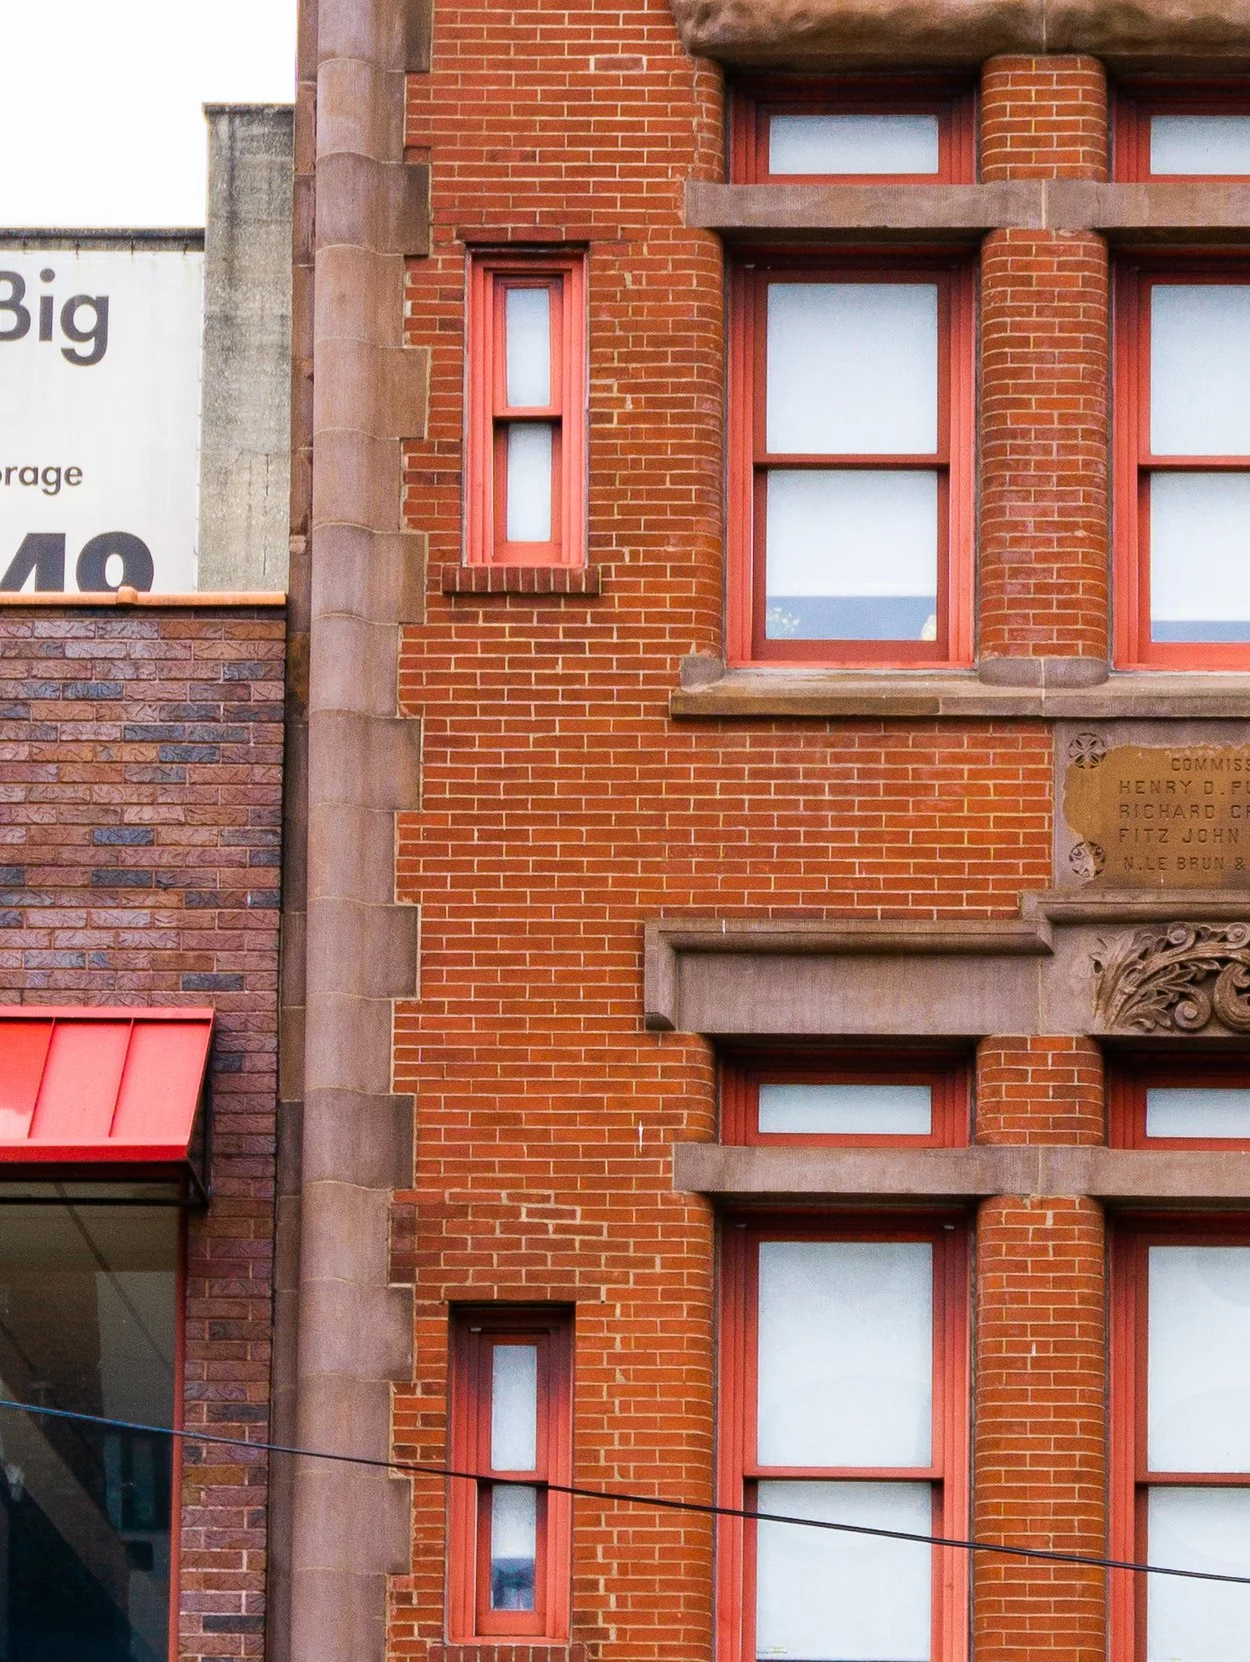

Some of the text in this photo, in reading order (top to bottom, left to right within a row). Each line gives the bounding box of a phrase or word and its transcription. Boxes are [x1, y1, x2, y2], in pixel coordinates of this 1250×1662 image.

[0, 465, 83, 496] rage
[1119, 780, 1192, 795] HENRY
[1119, 804, 1215, 819] RICHARD
[1119, 828, 1169, 843] FITZ
[1182, 828, 1239, 843] JOHN
[1177, 857, 1225, 871] BRUN
[1235, 857, 1246, 871] &
